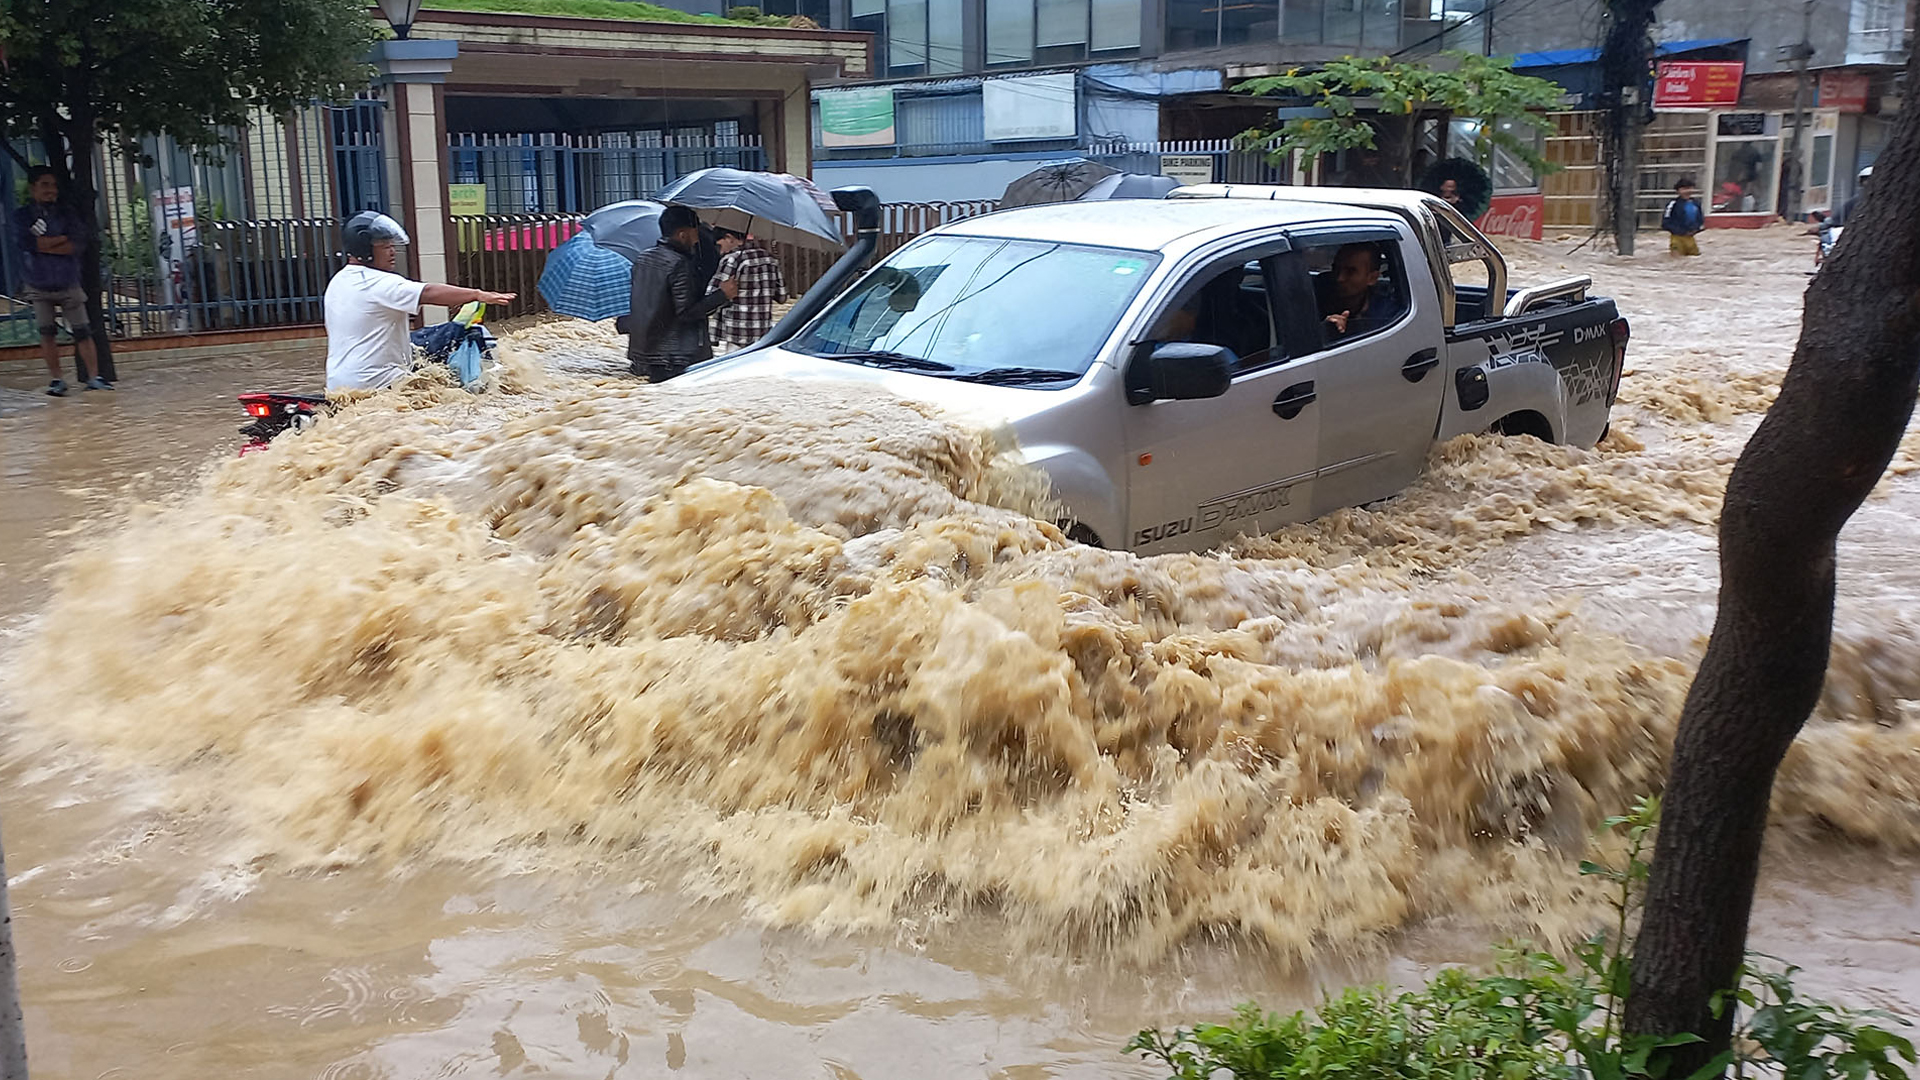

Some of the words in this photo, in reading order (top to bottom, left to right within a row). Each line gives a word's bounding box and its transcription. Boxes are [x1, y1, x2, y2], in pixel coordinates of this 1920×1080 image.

[1162, 157, 1179, 168] BIKE
[1180, 157, 1211, 167] PARKING
[1133, 517, 1193, 547] ISUZU
